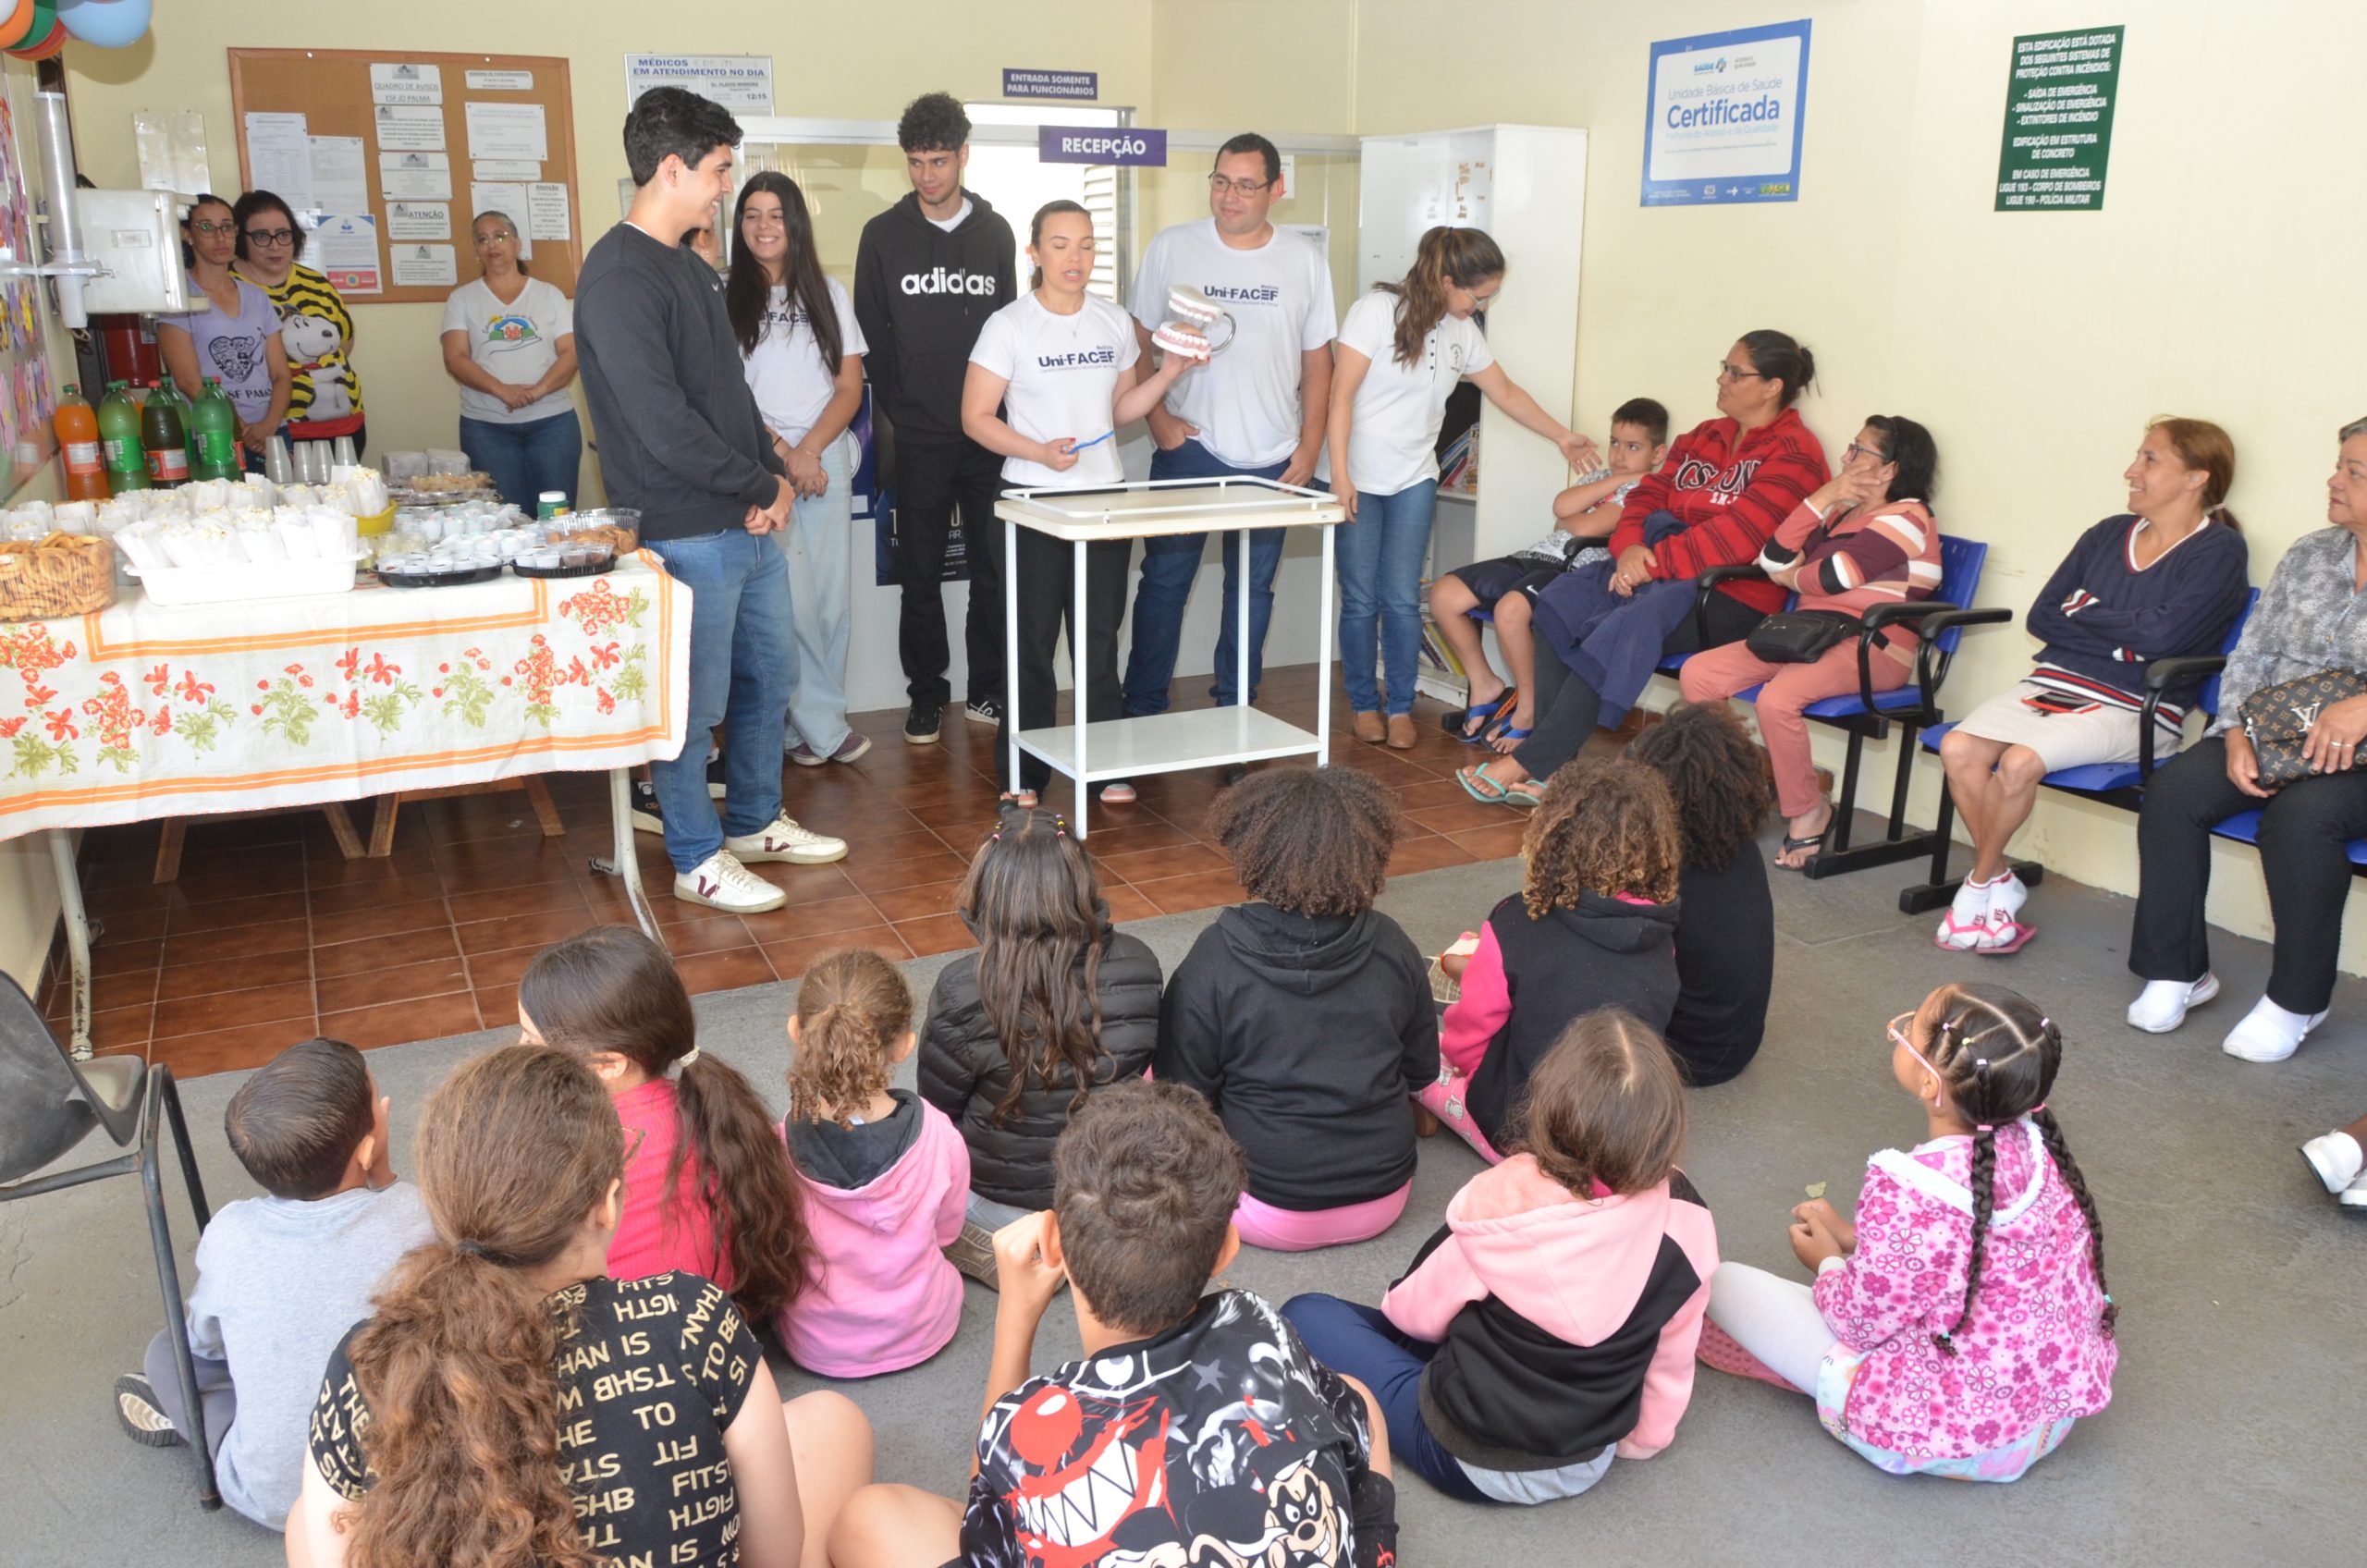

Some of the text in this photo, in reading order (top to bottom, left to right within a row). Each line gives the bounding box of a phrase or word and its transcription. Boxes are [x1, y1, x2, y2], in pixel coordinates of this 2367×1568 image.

[2017, 33, 2116, 53] ESTA EDIFICAÇÃO ESTÁ DOTADA
[638, 58, 689, 67] MÉDICOS
[2019, 47, 2111, 66] DOS SEGUINTES SISTEMAS DE
[1011, 73, 1090, 85] ENTRADA SOMENTE
[2016, 65, 2048, 80] PROTEÇÃO
[2048, 65, 2074, 76] CONTRA
[374, 82, 404, 91] QUADRO
[1007, 83, 1094, 96] PARA FUNCIONÁRIOS
[1668, 77, 1783, 101] Unidade Básica de Saúde
[2047, 87, 2057, 97] DE
[2057, 83, 2098, 97] EMERGÊNCIA
[1667, 94, 1781, 129] Certificada
[2016, 99, 2056, 113] SINALIZAÇÃO
[2056, 100, 2067, 110] DE
[2067, 96, 2106, 109] EMERGÊNCIA
[2020, 113, 2057, 126] EXTINTORES
[2058, 113, 2067, 124] DE
[2068, 110, 2099, 123] INCÊNDIO
[1061, 135, 1147, 158] RECEPÇÃO
[2013, 133, 2097, 149] EDIFICAÇÃO EM ESTRUTURA
[2031, 148, 2075, 159] DE CONCRETO
[2012, 165, 2090, 179] EM CASO DE EMERGÊNCIA
[1999, 182, 2017, 192] LIGUE
[2017, 182, 2029, 192] 193
[2032, 181, 2054, 192] CORPO
[2054, 181, 2064, 191] DE
[2064, 180, 2102, 191] BOMBEIROS
[2005, 195, 2024, 205] LIGUE
[2025, 195, 2036, 205] 190
[2040, 192, 2064, 205] POLÍCIA
[2064, 193, 2091, 205] MILITAR
[409, 210, 444, 219] ATENÇÃO
[901, 267, 996, 296] adidas
[1204, 286, 1279, 300] Uni-FACEF
[1038, 351, 1115, 367] Uni-FACEF
[227, 388, 272, 398] SF PAL
[1674, 458, 1761, 495] OSON
[613, 1293, 680, 1322] IGTH
[557, 1331, 651, 1378] HAN IS
[555, 1402, 676, 1452] HE TO
[555, 1435, 698, 1486] FIT STA
[571, 1487, 635, 1519] SHB
[579, 1524, 621, 1549] TH
[671, 1538, 698, 1564] IS
